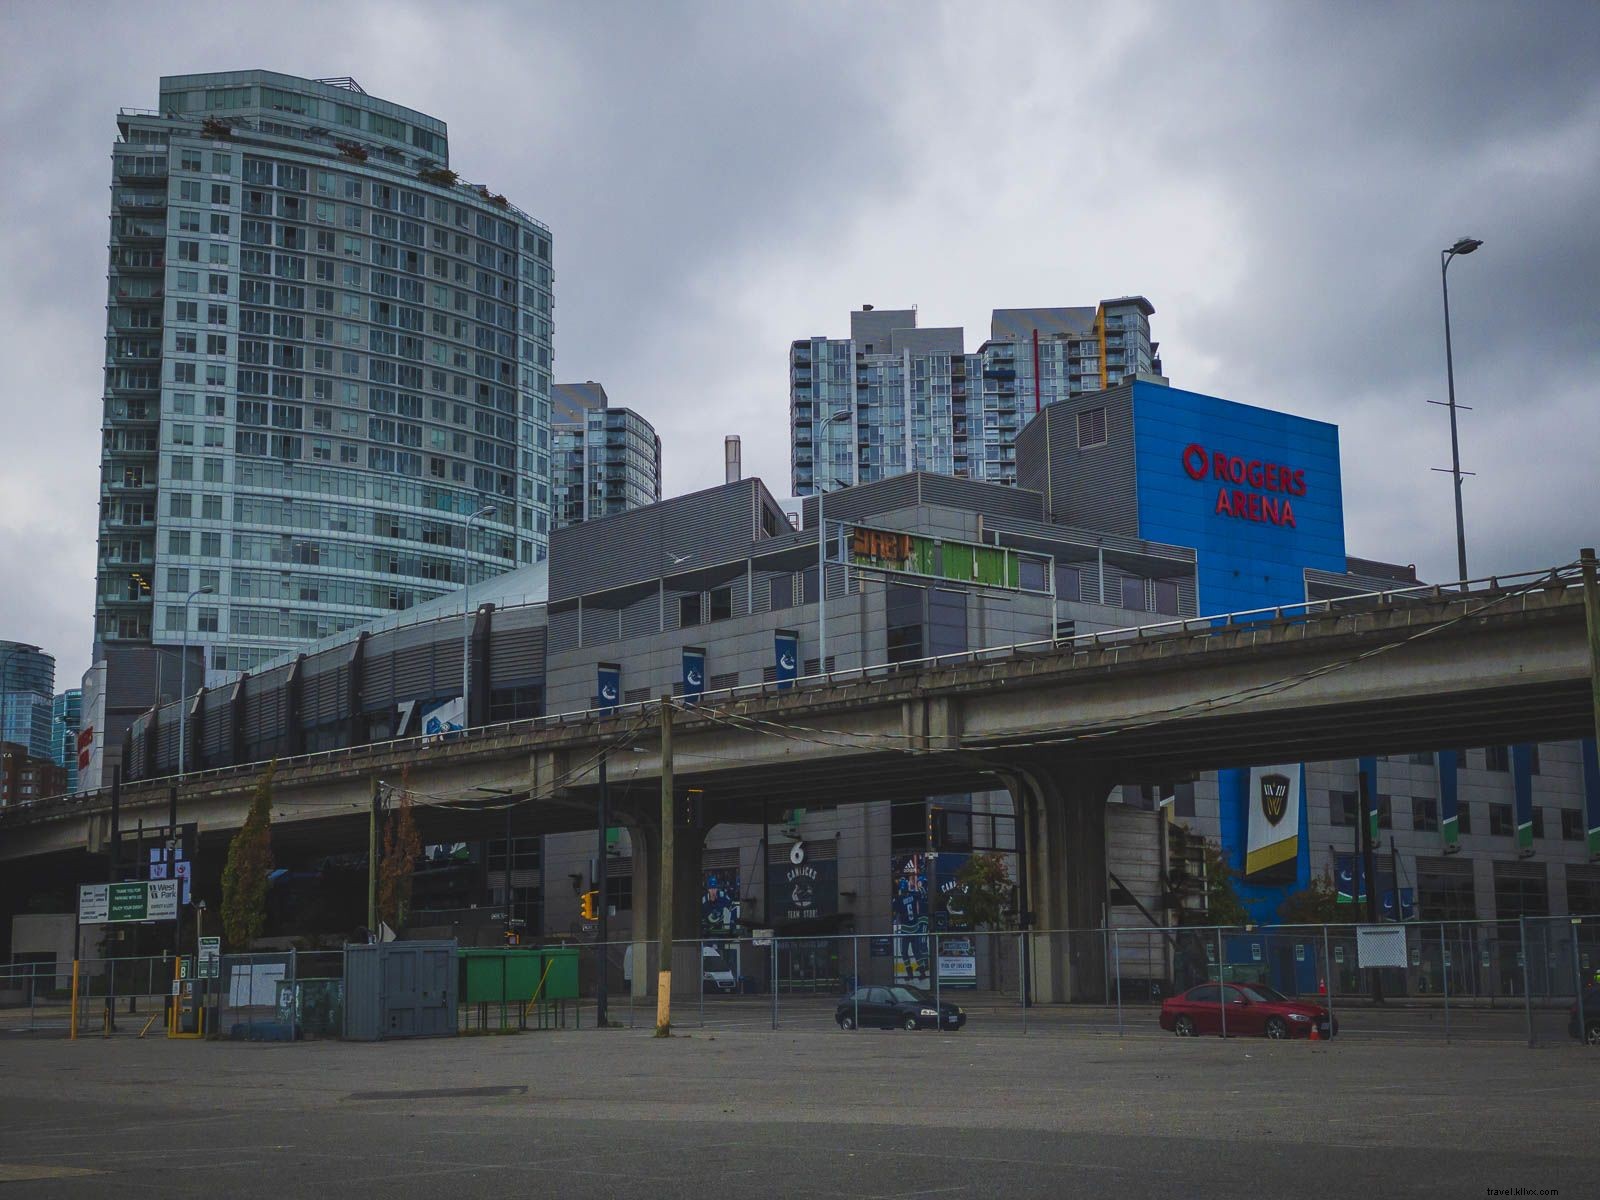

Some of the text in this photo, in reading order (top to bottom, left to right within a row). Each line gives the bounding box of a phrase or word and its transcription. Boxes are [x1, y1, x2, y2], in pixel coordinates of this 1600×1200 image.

[1213, 452, 1306, 497] ROGERS
[1215, 487, 1297, 529] ARENA
[396, 700, 416, 736] 7
[790, 841, 804, 865] 6
[787, 867, 817, 881] CANUCKS
[157, 883, 175, 891] West
[161, 890, 177, 899] Park
[787, 910, 800, 919] TEAM
[180, 966, 186, 978] B
